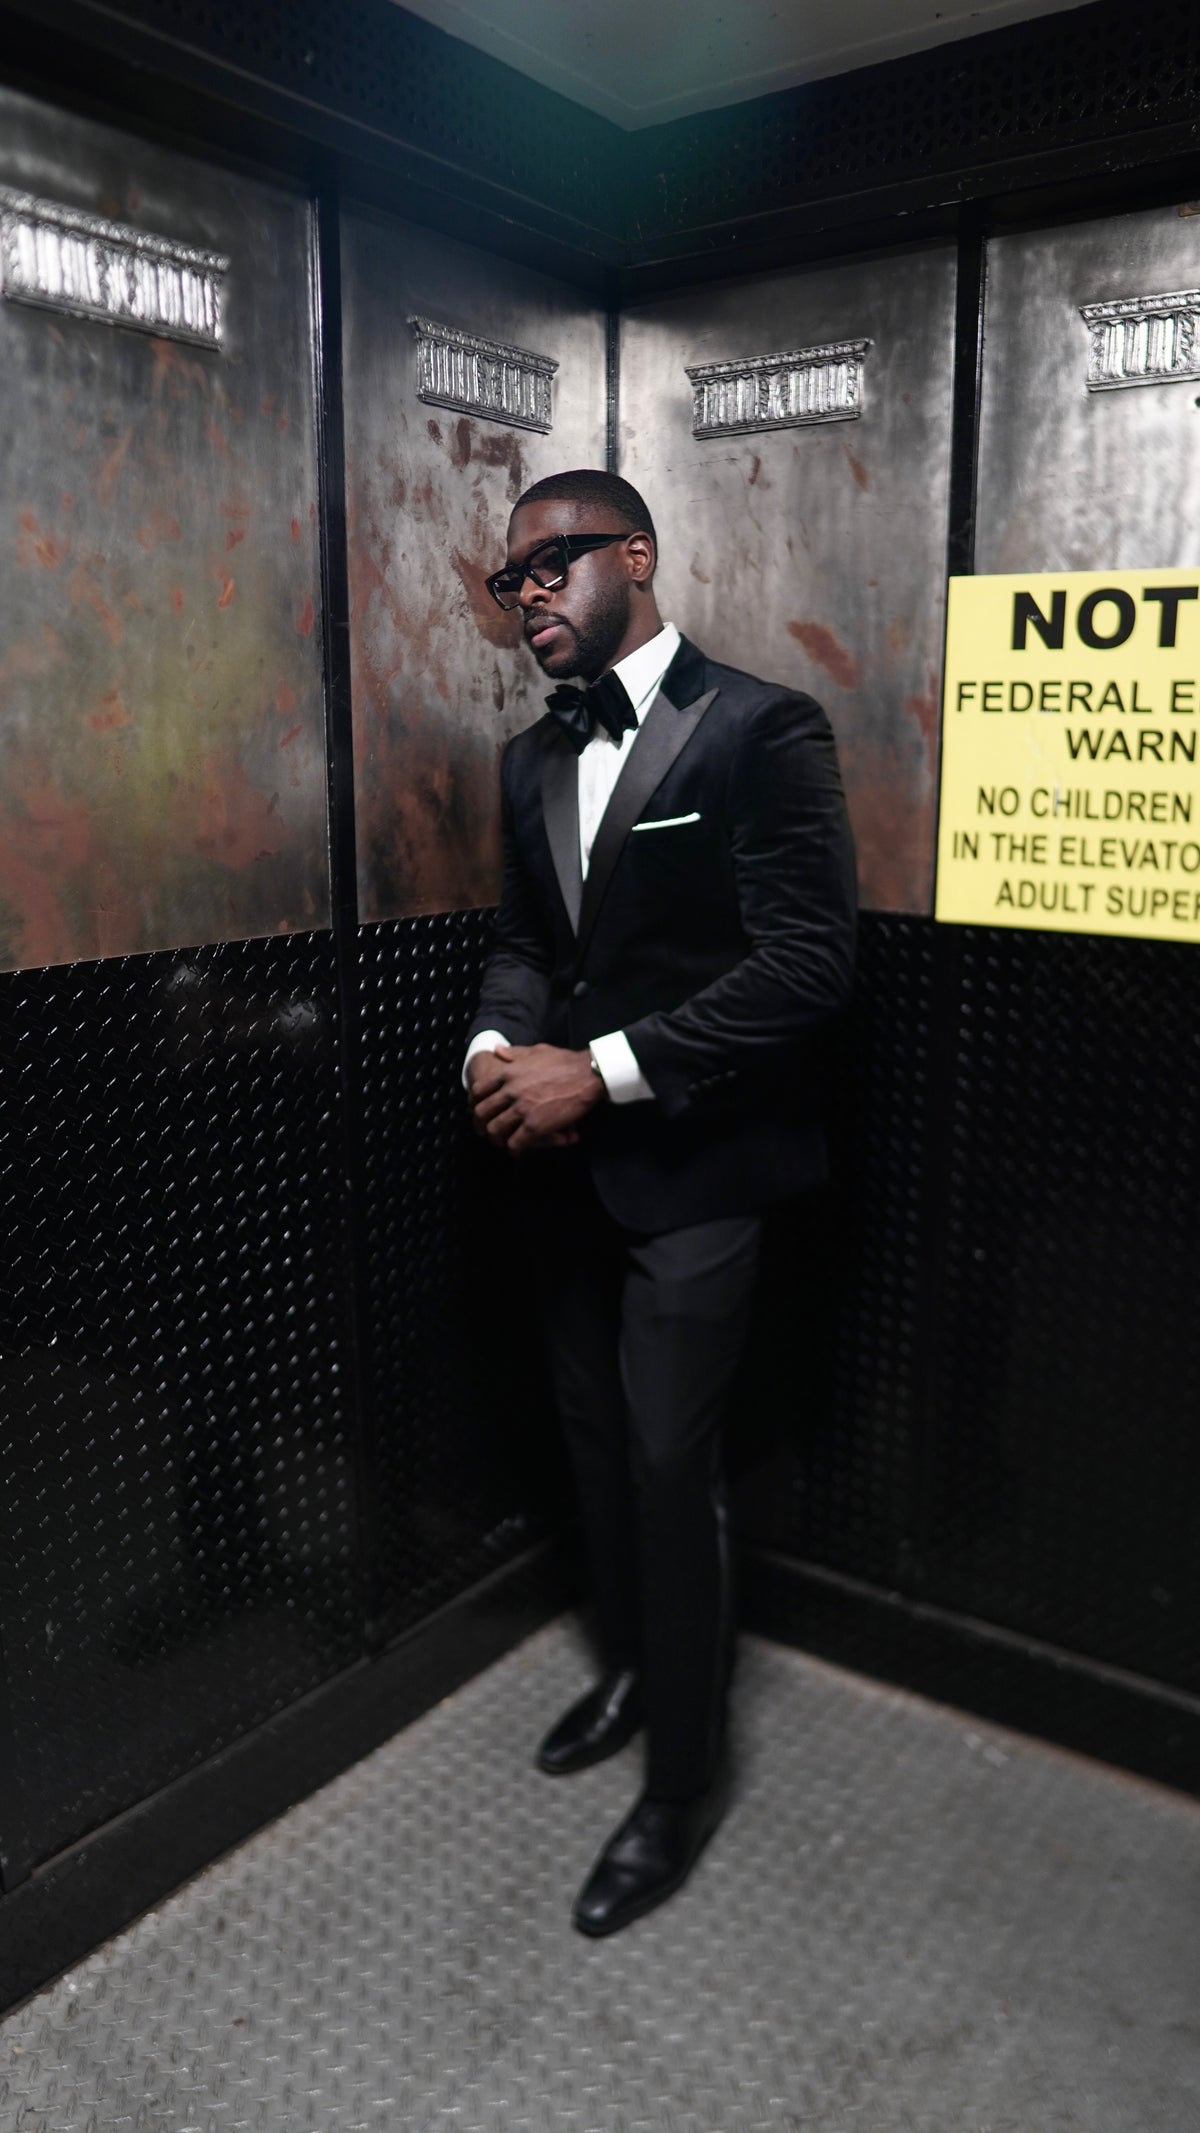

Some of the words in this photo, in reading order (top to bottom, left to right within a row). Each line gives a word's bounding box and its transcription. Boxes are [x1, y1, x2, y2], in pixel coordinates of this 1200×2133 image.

[1011, 586, 1200, 651] NOT
[956, 681, 1153, 713] FEDERAL
[1170, 681, 1200, 713] E
[1066, 729, 1197, 762] WARN
[977, 786, 1019, 816] NO
[1031, 788, 1191, 823] CHILDREN
[953, 831, 979, 860] IN
[991, 833, 1047, 864] THE
[1060, 836, 1200, 873] ELEVATO
[996, 881, 1095, 911] ADULT
